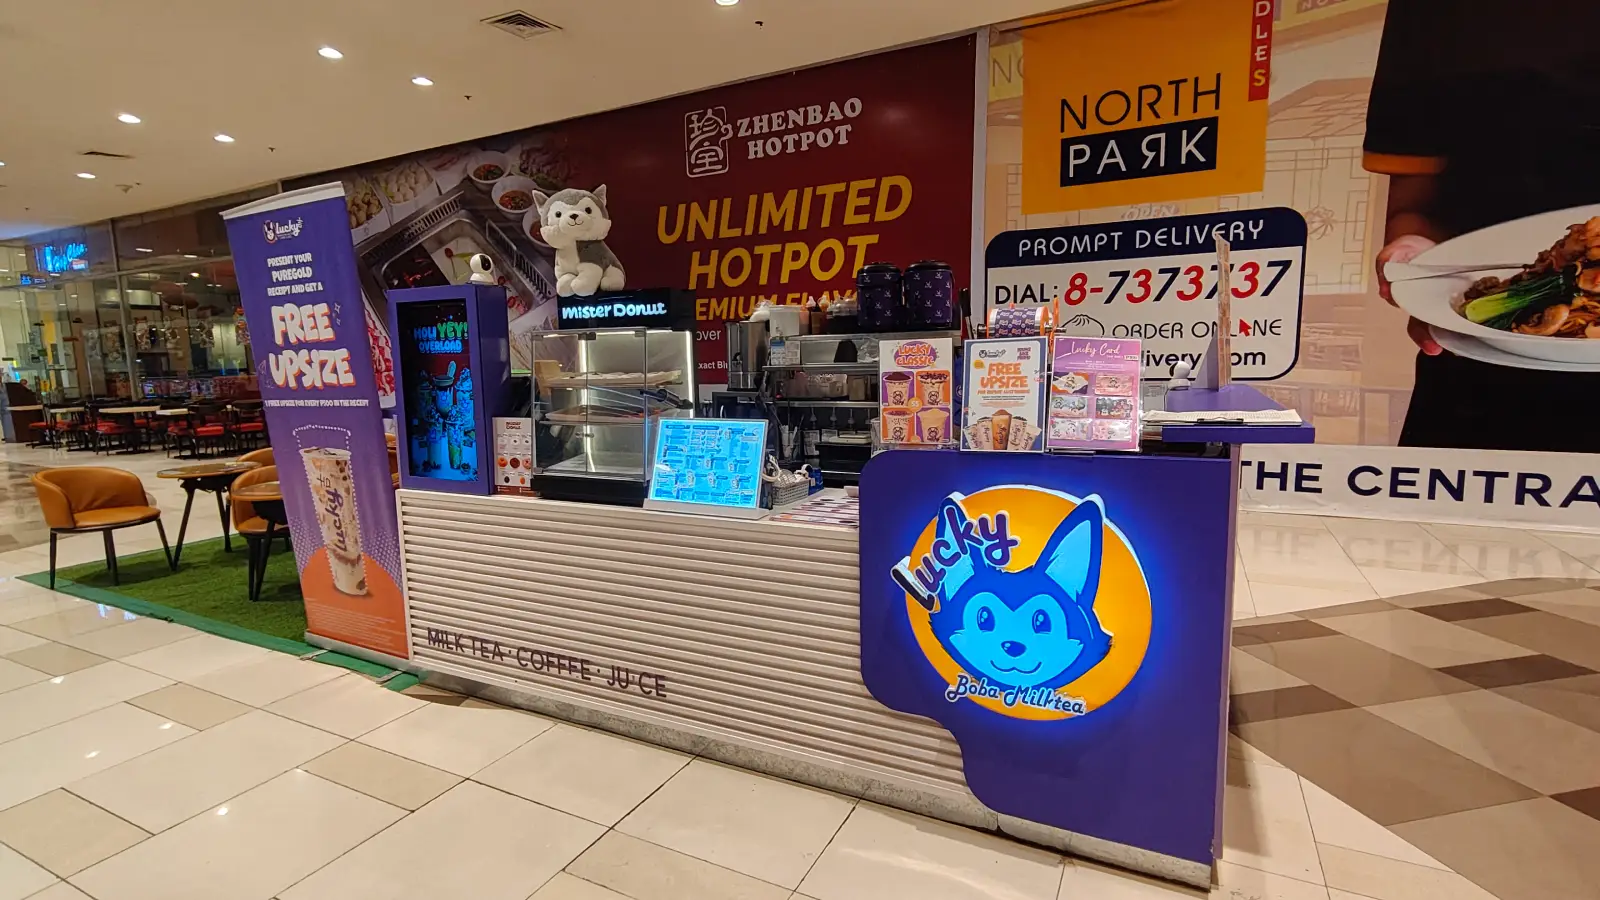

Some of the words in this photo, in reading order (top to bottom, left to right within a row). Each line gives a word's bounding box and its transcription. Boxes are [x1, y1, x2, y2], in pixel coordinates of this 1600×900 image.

[1060, 72, 1221, 133] NORTH
[736, 97, 862, 138] ZHENBAO
[747, 124, 852, 159] HOTPOT
[657, 175, 913, 244] UNLIMITED
[1018, 231, 1123, 257] PROMPT
[1135, 219, 1264, 249] DELIVERY
[267, 255, 293, 268] PRESENT
[293, 252, 313, 264] YOUR
[688, 234, 880, 290] HOTPOT
[271, 266, 313, 283] PUREGOLD
[267, 285, 291, 297] RECEIPT
[291, 283, 305, 294] AND
[304, 282, 317, 293] GET
[317, 281, 324, 291] A
[994, 284, 1059, 305] DIAL:
[613, 301, 667, 317] Donut
[271, 302, 336, 347] FREE
[1112, 322, 1183, 340] ORDER
[418, 340, 463, 353] OVERLOAD
[898, 344, 932, 356] LUCKY
[1071, 341, 1097, 357] Lucky
[1099, 342, 1121, 356] Card
[268, 347, 356, 391] UPSIZE
[896, 355, 934, 367] CLASSIC
[988, 362, 1022, 376] FREE
[980, 375, 1029, 389] UPSIZE
[427, 626, 465, 653] MILK
[467, 634, 504, 662] TEA
[606, 665, 667, 698] JUCE
[946, 673, 999, 702] Boba
